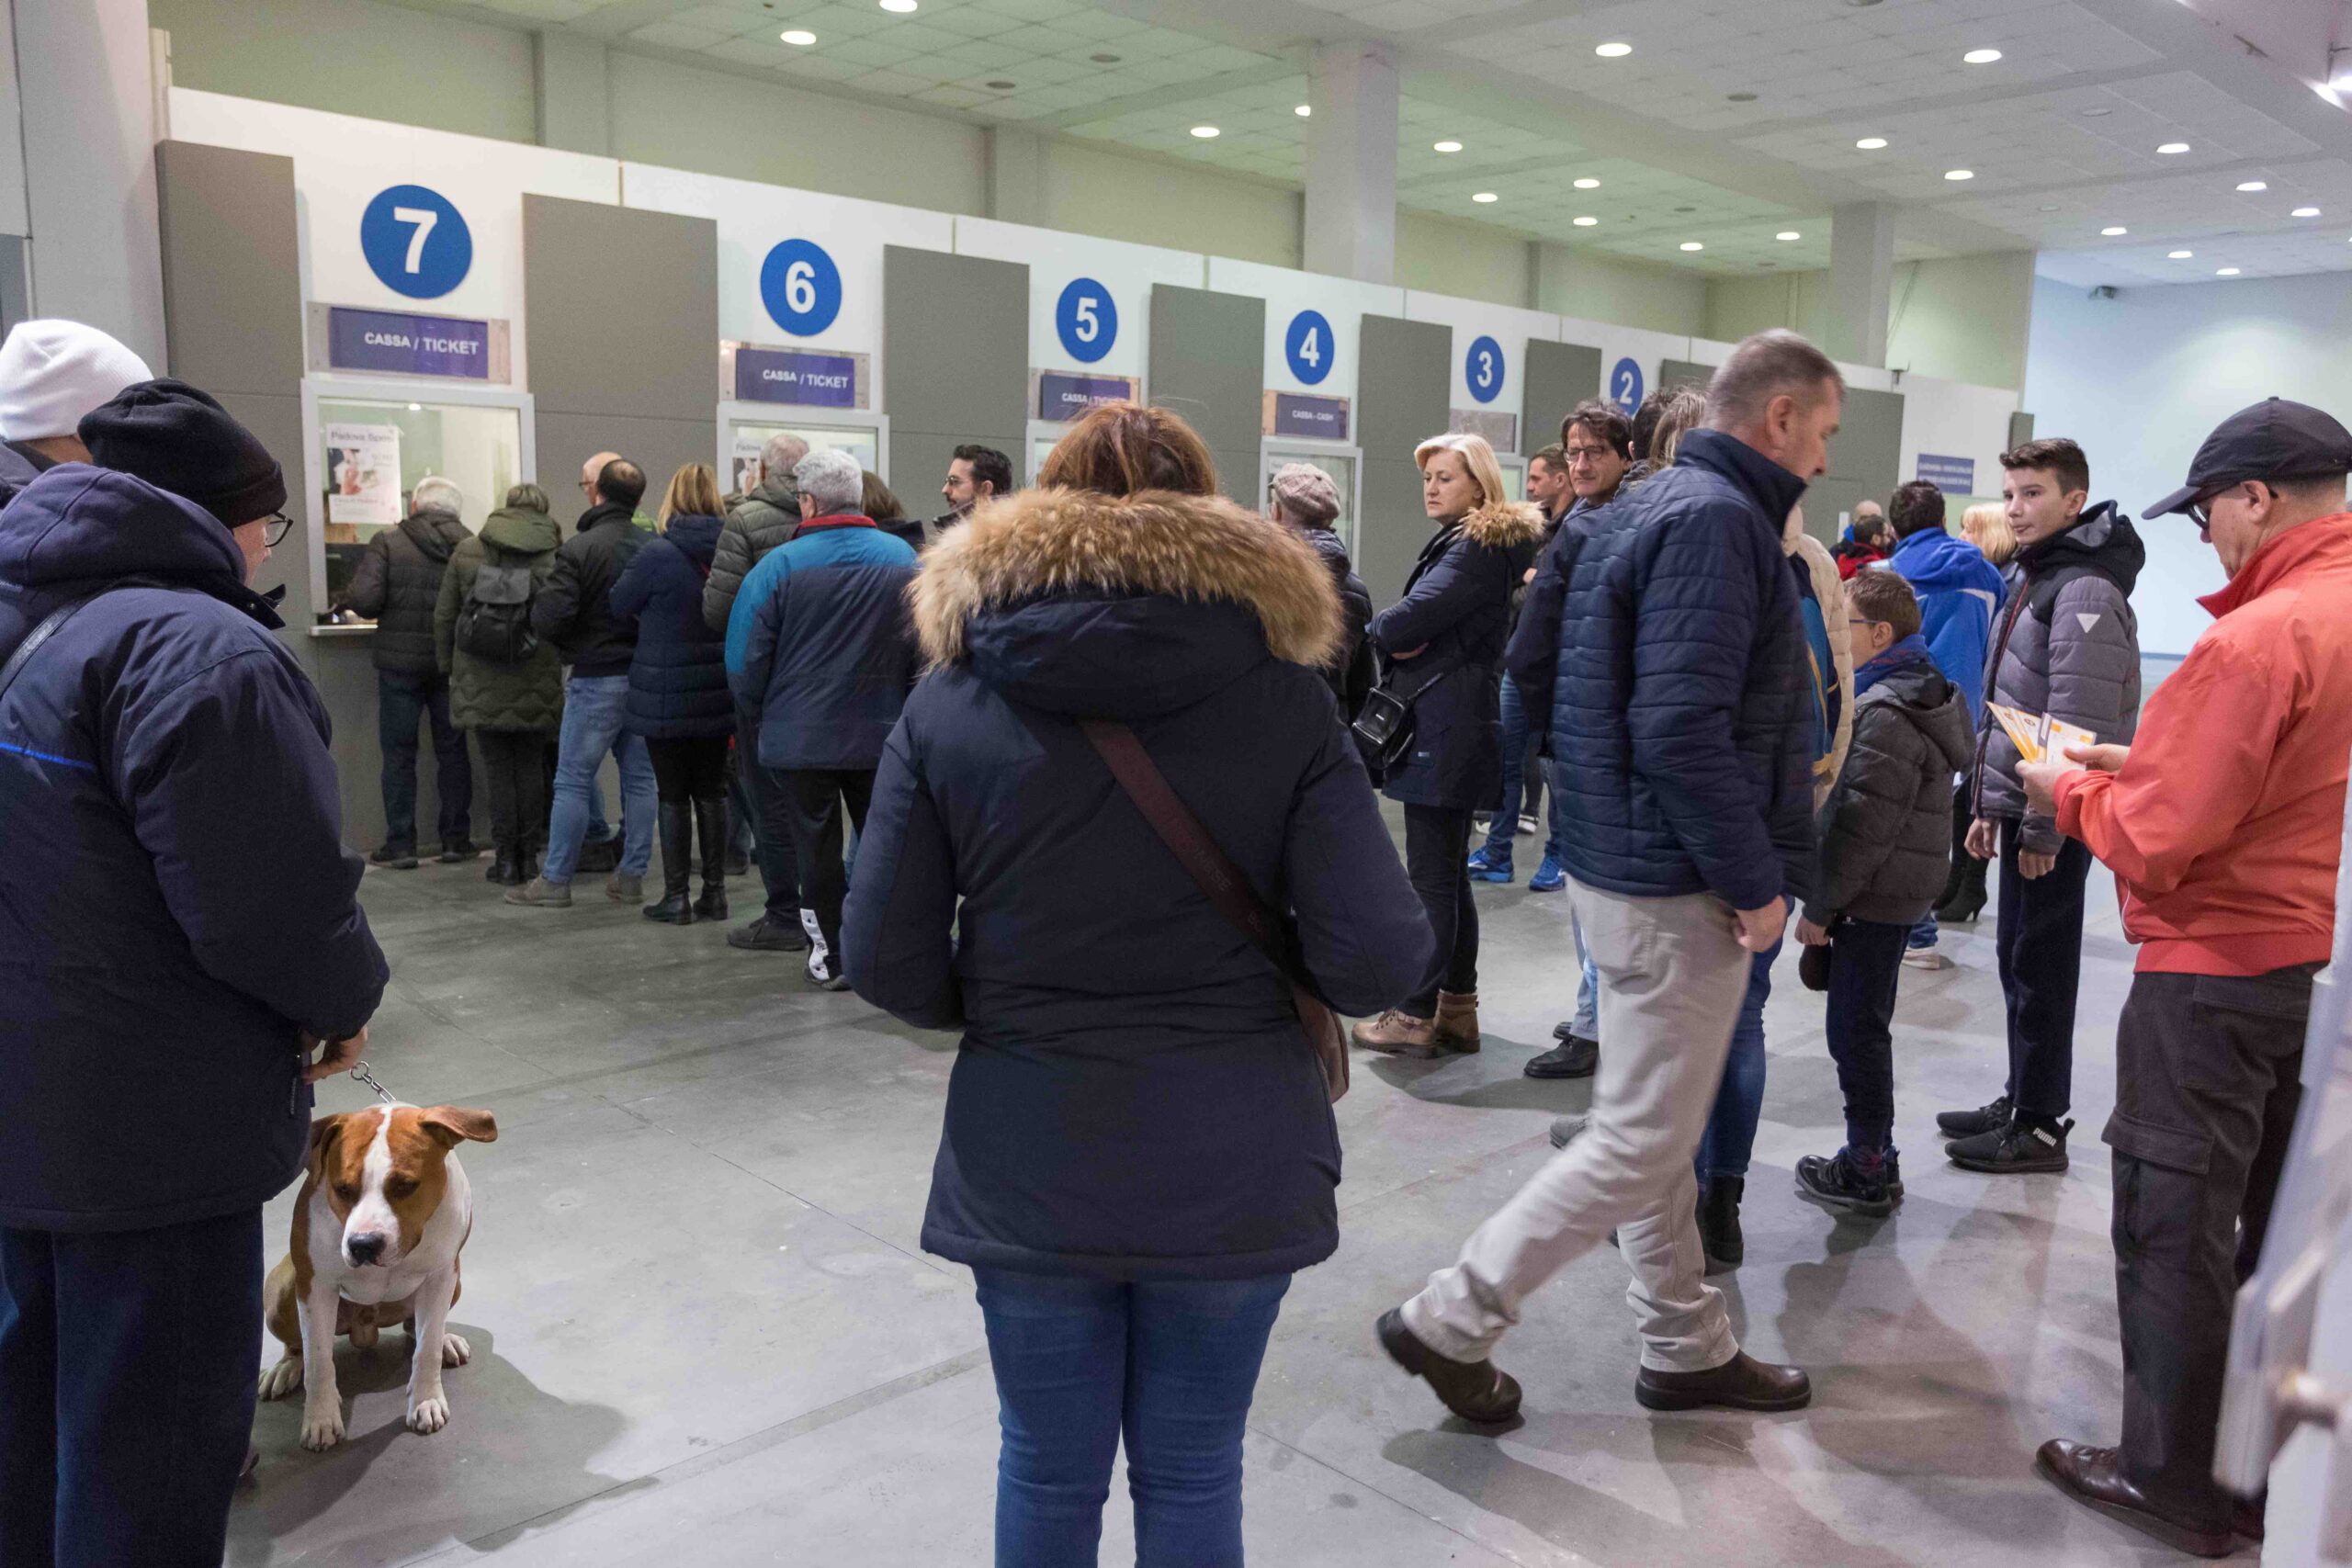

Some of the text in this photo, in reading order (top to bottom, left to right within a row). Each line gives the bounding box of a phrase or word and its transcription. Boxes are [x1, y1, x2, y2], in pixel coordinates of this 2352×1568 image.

[393, 206, 438, 274] 7
[786, 260, 816, 314] 6
[1075, 297, 1099, 343] 5
[364, 332, 412, 348] CASSA
[423, 337, 480, 355] TICKET
[1299, 326, 1320, 367] 4
[763, 369, 797, 382] CASSA
[807, 374, 849, 389] TICKET
[1477, 351, 1493, 388] 3
[1619, 370, 1634, 404] 2
[1061, 392, 1088, 403] CASSA
[2032, 1127, 2057, 1147] PUMA
